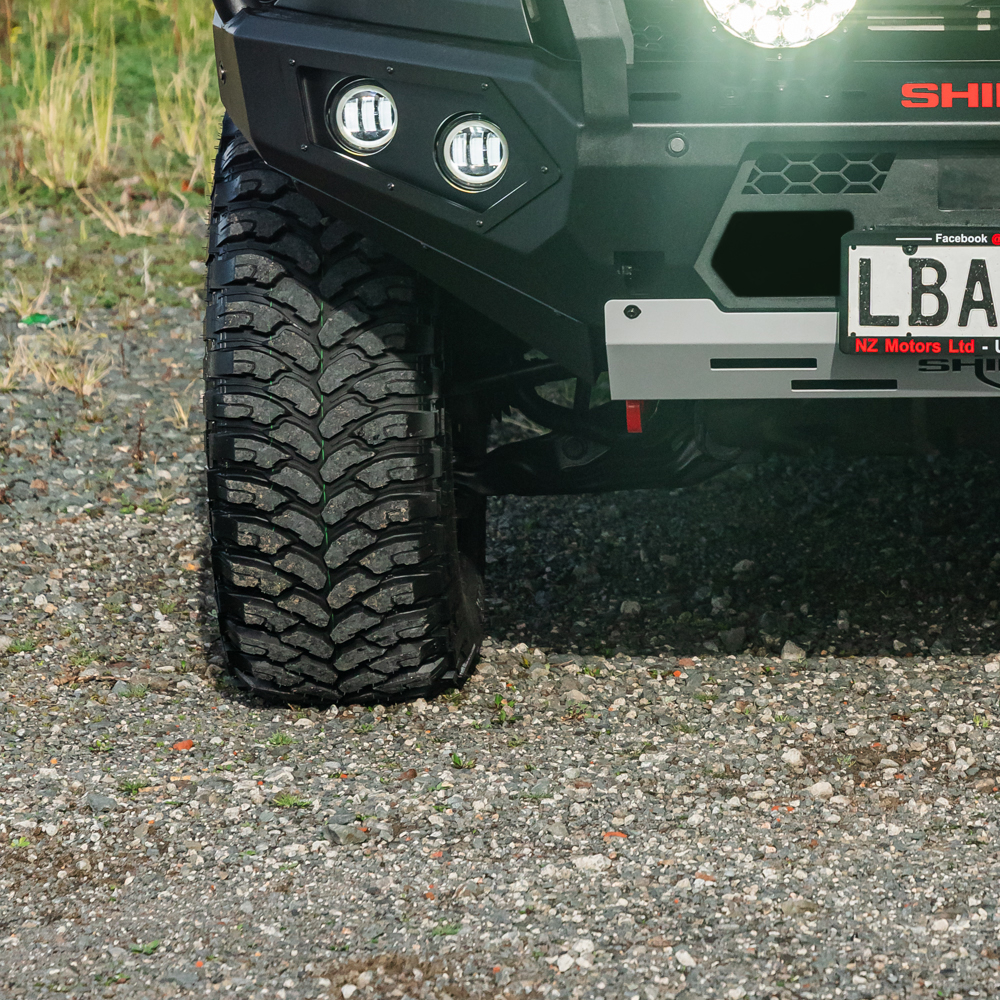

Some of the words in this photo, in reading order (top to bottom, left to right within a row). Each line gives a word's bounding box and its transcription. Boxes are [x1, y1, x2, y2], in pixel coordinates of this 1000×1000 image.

[935, 233, 988, 243] Facebook
[855, 338, 878, 353] NZ
[885, 338, 941, 353] Motors
[948, 339, 975, 353] Ltd
